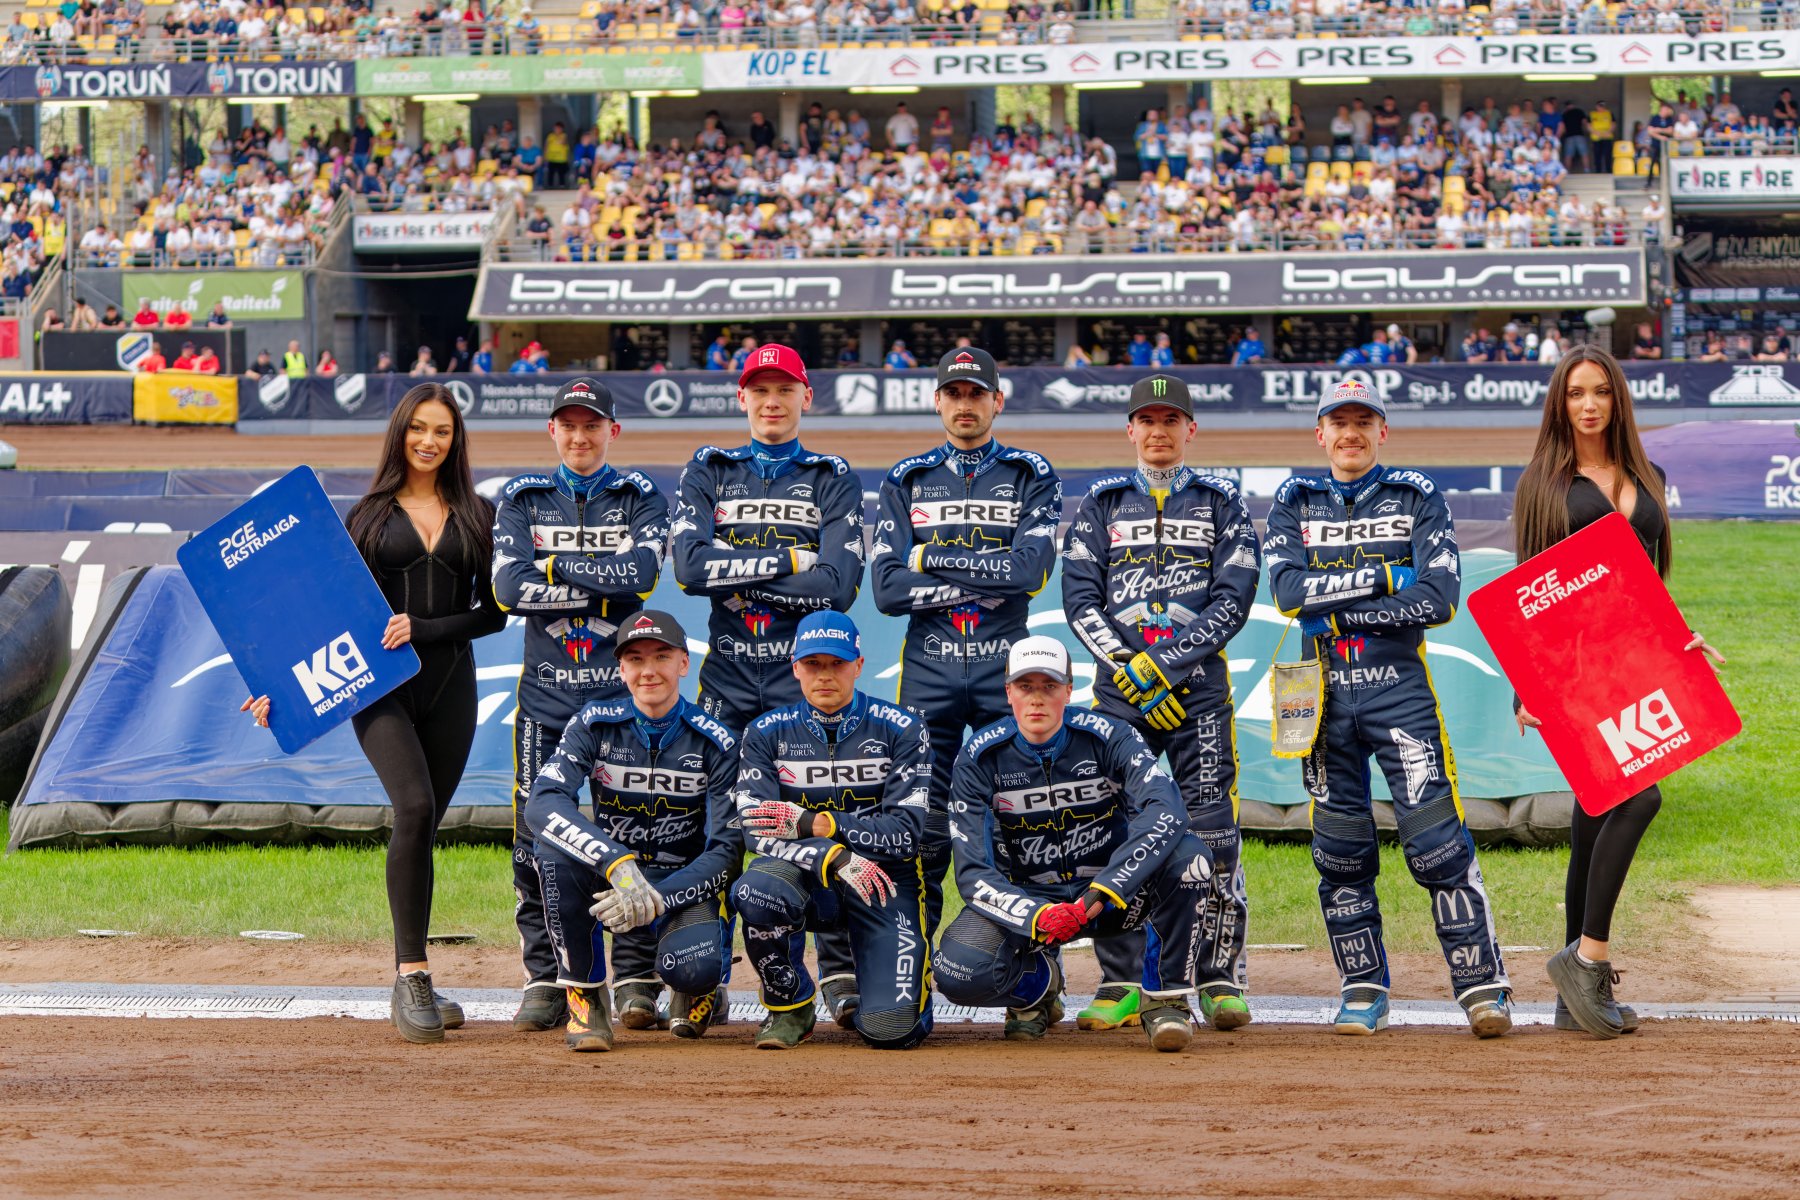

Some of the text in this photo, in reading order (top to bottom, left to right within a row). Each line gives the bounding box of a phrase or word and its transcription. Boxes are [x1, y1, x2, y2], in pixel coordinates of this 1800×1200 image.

[1114, 49, 1229, 71] PRES
[1296, 45, 1413, 67] PRES
[1481, 43, 1598, 64] PRES
[1667, 40, 1786, 62] PRES
[934, 53, 1048, 75] PRES
[64, 63, 171, 97] TORUŃ
[236, 61, 343, 95] TORUŃ
[947, 362, 981, 372] PRES
[563, 390, 597, 401] PRES
[1334, 390, 1369, 399] Red Bull
[893, 455, 937, 478] CANAL+
[1005, 451, 1050, 476] APRO
[505, 473, 550, 495] CANAL+
[1277, 477, 1317, 503] CANAL+
[1388, 471, 1435, 494] APRO
[792, 489, 813, 498] PGE
[995, 489, 1014, 498] PGE
[606, 513, 623, 522] PGE
[736, 503, 819, 525] PRES
[940, 504, 1022, 523] PRES
[1378, 504, 1398, 514] PGE
[218, 520, 258, 558] PGE
[223, 513, 300, 570] EKSTRALIGA
[1131, 523, 1216, 544] PRES
[1320, 520, 1412, 543] PRES
[559, 562, 638, 576] NICOLAUS
[704, 556, 779, 580] TMC
[926, 555, 1012, 572] NICOLAUS
[599, 577, 640, 585] BANK
[970, 572, 1012, 581] BANK
[1112, 560, 1207, 604] KS Apator
[1303, 567, 1376, 596] TMC
[1316, 594, 1339, 602] since
[1516, 568, 1561, 608] PGE
[1520, 563, 1610, 620] EKSTRALIGA
[557, 601, 576, 609] 1993
[745, 589, 833, 609] NICOLAUS
[1345, 600, 1434, 626] NICOLAUS
[627, 627, 663, 638] PRES
[800, 628, 850, 642] MAGIK
[1159, 599, 1238, 665] NICOLAUS
[1212, 611, 1244, 645] BANK
[941, 638, 1012, 657] PLEWA
[923, 654, 947, 663] HALE
[555, 667, 622, 683] PLEWA
[1328, 665, 1400, 685] PLEWA
[537, 682, 562, 690] HALE
[582, 706, 625, 725] CANAL+
[756, 710, 800, 729] CANAL+
[869, 703, 913, 728] APRO
[1281, 708, 1315, 719] 2025
[691, 714, 737, 752] APRO
[520, 716, 531, 793] AutoAndreas
[864, 745, 883, 754] PGE
[1198, 712, 1219, 782] REXER
[683, 760, 703, 768] PGE
[806, 763, 891, 784] PRES
[1077, 766, 1097, 776] PGE
[622, 771, 708, 794] PRES
[1001, 772, 1027, 780] MIASTO
[1023, 782, 1112, 810] PRES
[547, 811, 610, 862] TMC
[602, 809, 700, 845] Apator
[1153, 818, 1183, 856] BANK
[1019, 814, 1112, 866] Apator
[1111, 812, 1175, 888] NICOLAUS
[755, 836, 819, 866] TMC
[873, 847, 913, 855] BANK
[1425, 845, 1462, 870] AUTO FRELIK
[1324, 861, 1362, 872] AUTO FRELIK
[662, 870, 729, 912] NICOLAUS
[698, 883, 728, 904] BANK
[973, 880, 1037, 919] TMC
[748, 896, 788, 915] AUTO FRELIK
[1326, 900, 1373, 919] PRES
[748, 924, 795, 940] Pentel
[674, 939, 713, 956] Mercedes-Benz
[677, 946, 716, 966] AUTO FRELIK
[1341, 937, 1366, 954] MU
[895, 918, 917, 1003] MAGIK
[1345, 953, 1371, 970] RA
[1451, 964, 1493, 977] GADOMSKA
[939, 964, 973, 982] AUTO FRELIK
